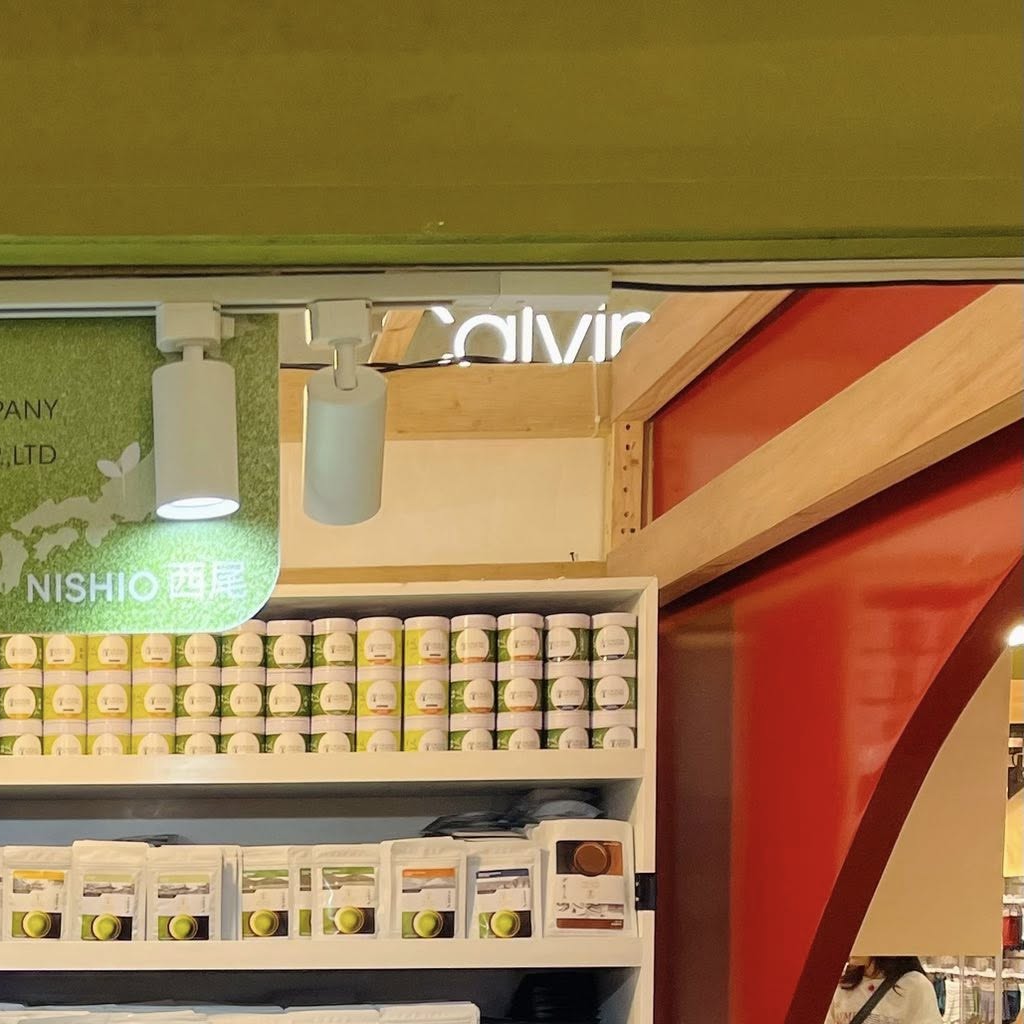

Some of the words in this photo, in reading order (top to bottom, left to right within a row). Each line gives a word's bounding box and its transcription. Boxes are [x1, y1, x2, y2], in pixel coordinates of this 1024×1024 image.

[431, 303, 651, 365] alvi
[26, 570, 159, 603] NISHIO
[164, 561, 247, 600] 西尾
